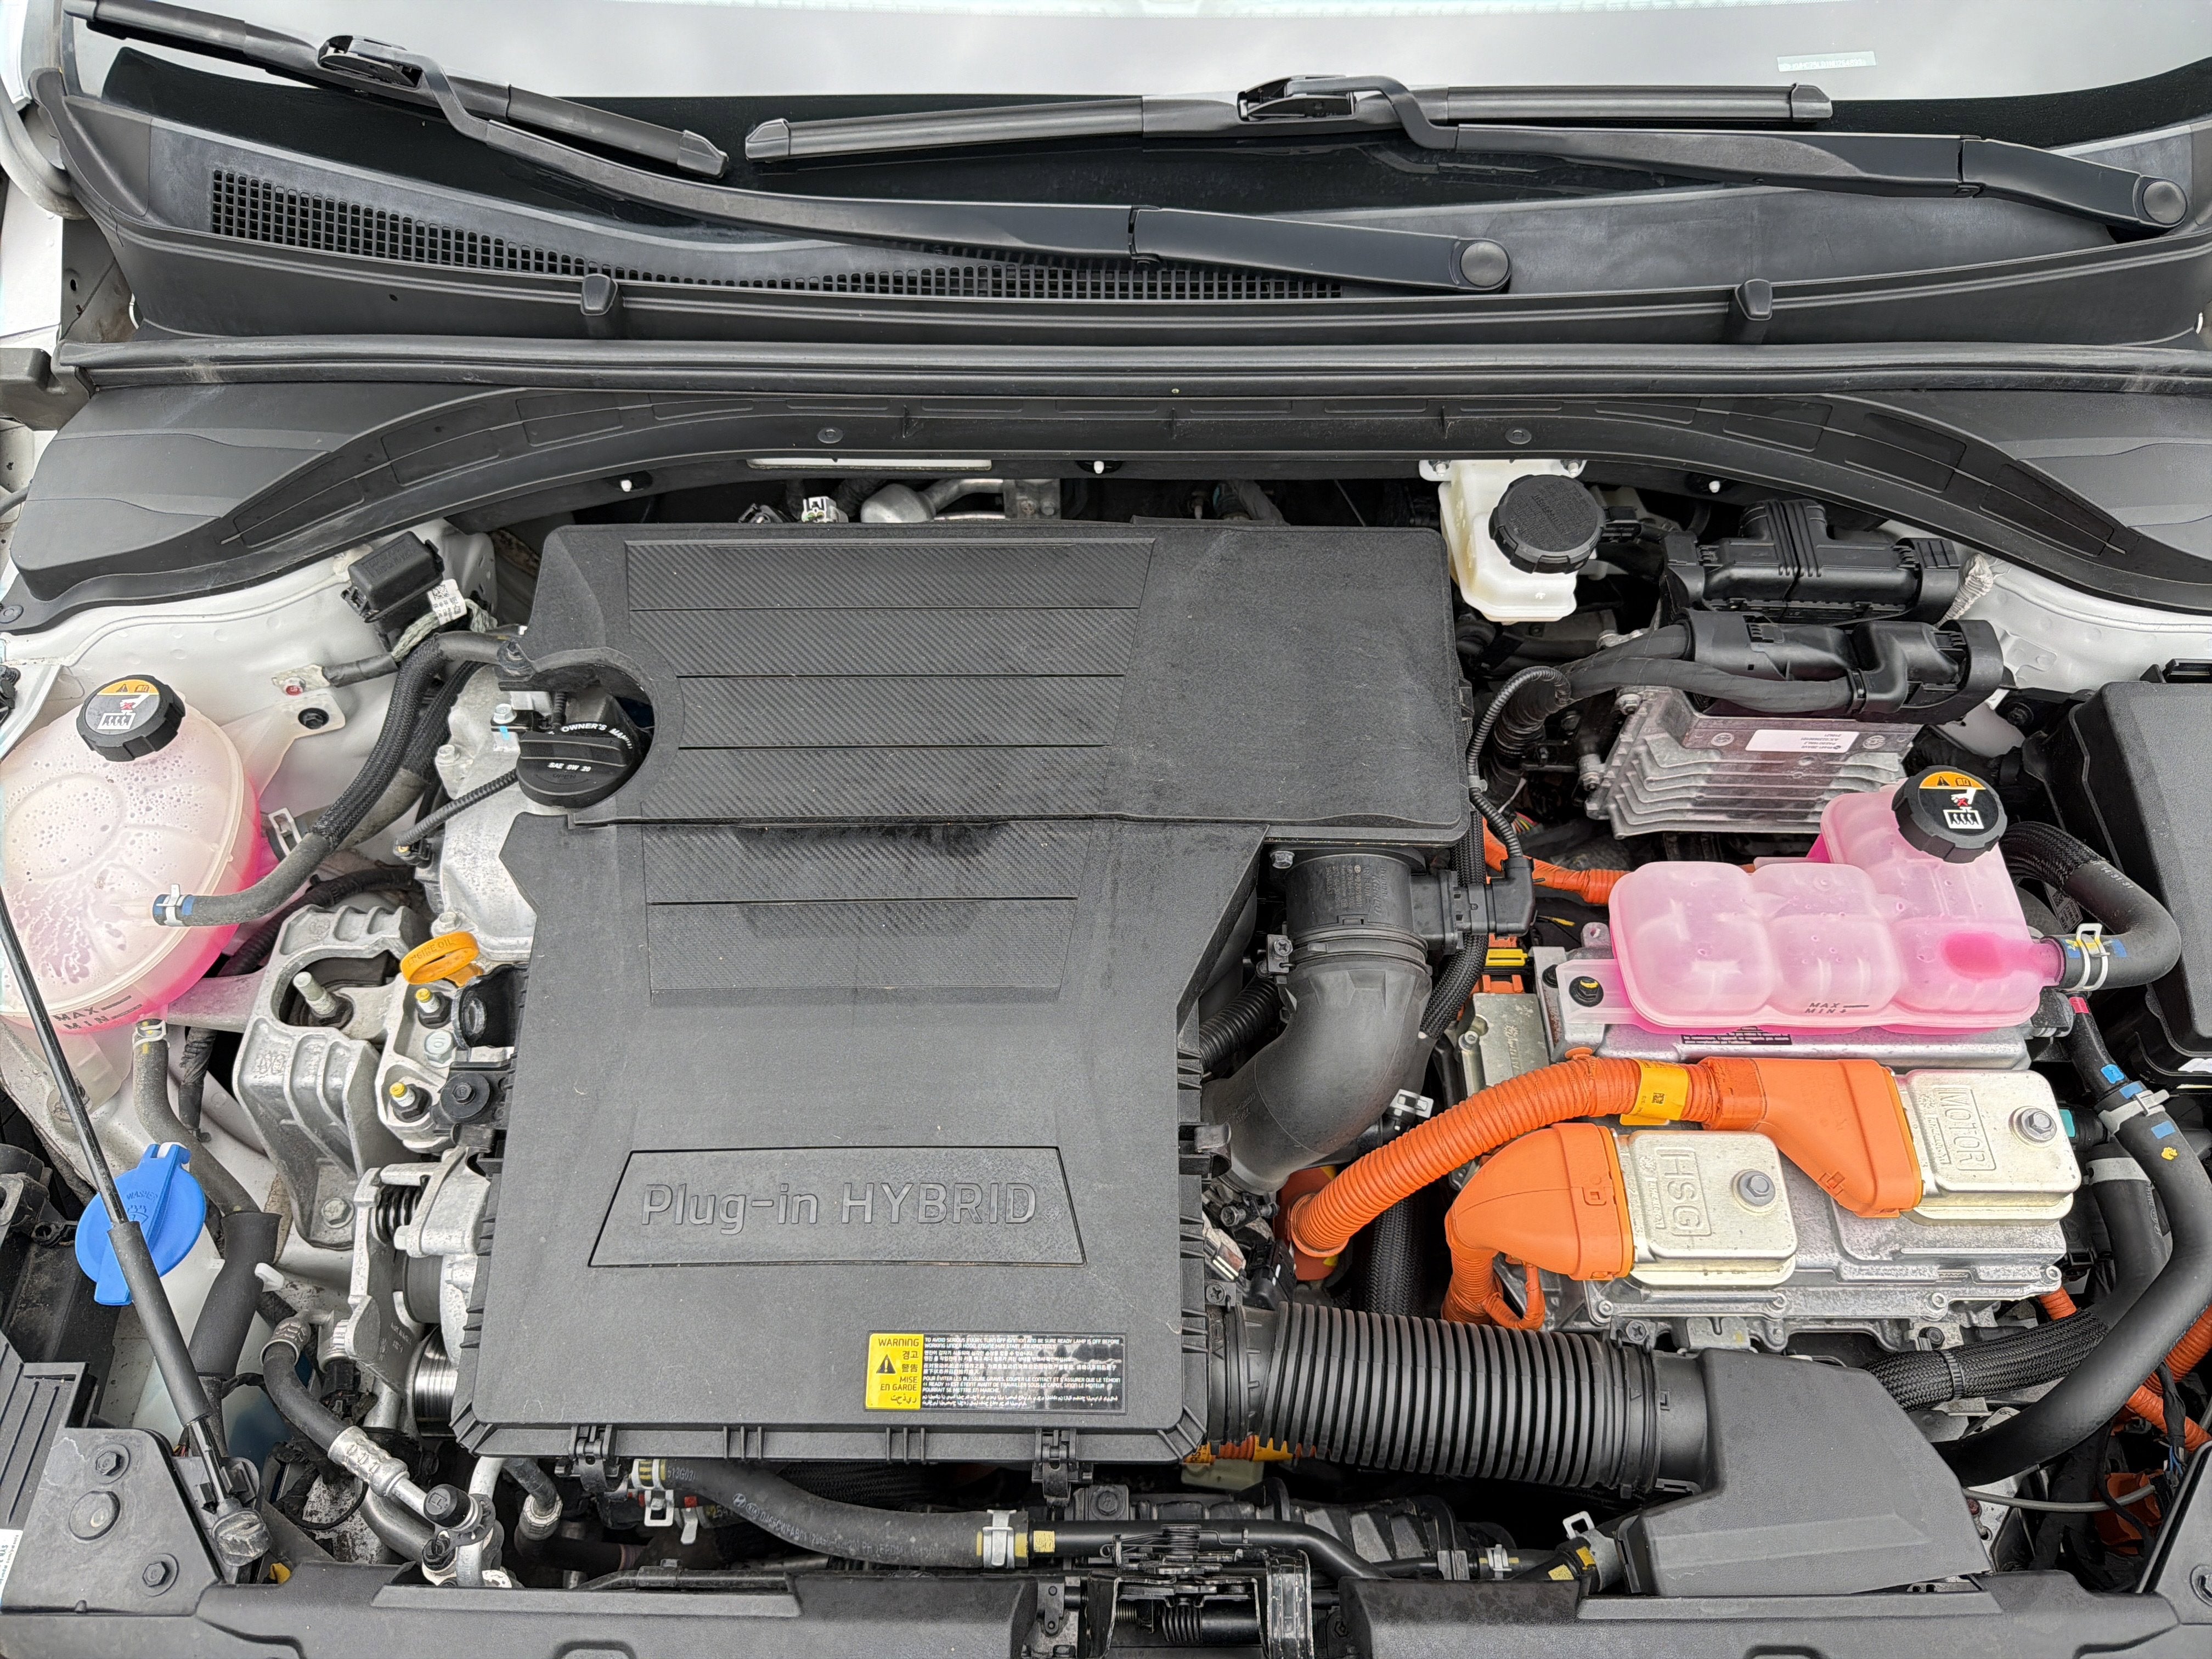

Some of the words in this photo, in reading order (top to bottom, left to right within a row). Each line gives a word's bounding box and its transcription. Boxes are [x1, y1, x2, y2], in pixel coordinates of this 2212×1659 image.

[560, 723, 608, 733] OWNER'S
[408, 944, 437, 966] ENGINE
[438, 938, 456, 949] OIL
[52, 1006, 100, 1021] MAX
[63, 1015, 110, 1030] MIN
[1938, 1091, 1986, 1164] MOTOR
[1660, 1153, 1703, 1230] HSG
[640, 1182, 819, 1236] Plug-in
[841, 1182, 1037, 1225] HYBRID
[878, 1338, 919, 1347] WARNING
[902, 1350, 919, 1360] 경고
[901, 1364, 918, 1373] 警告
[890, 1394, 917, 1405] تحذير
